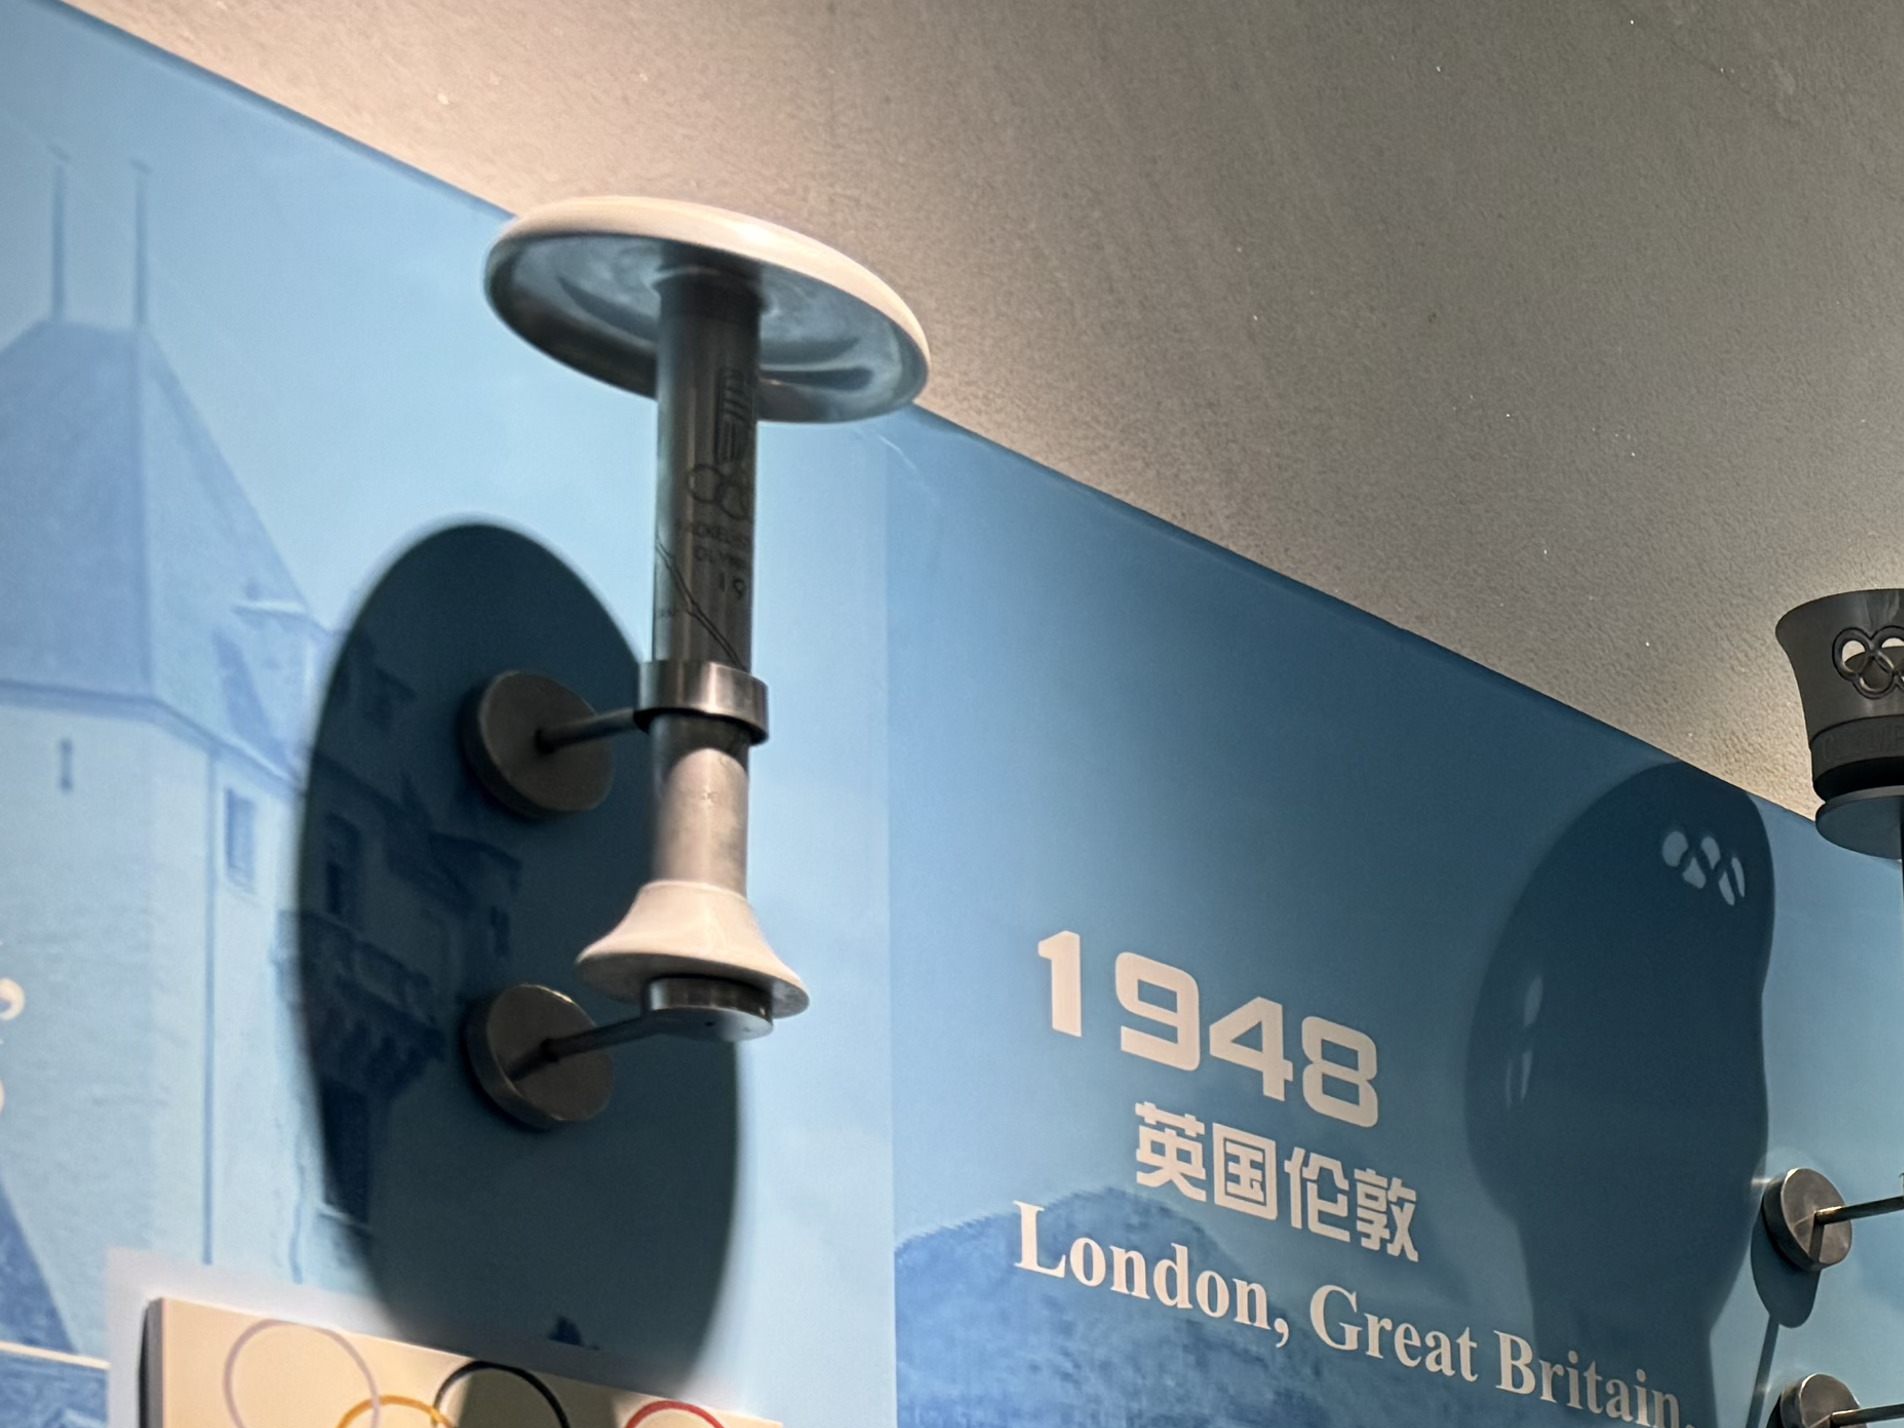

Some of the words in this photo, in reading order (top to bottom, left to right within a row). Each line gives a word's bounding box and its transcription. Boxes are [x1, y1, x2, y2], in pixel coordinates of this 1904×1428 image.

[1036, 929, 1379, 1128] 1948
[1133, 1101, 1420, 1262] 英国伦敦
[1013, 1199, 1289, 1350] London,
[1309, 1282, 1477, 1384] Great
